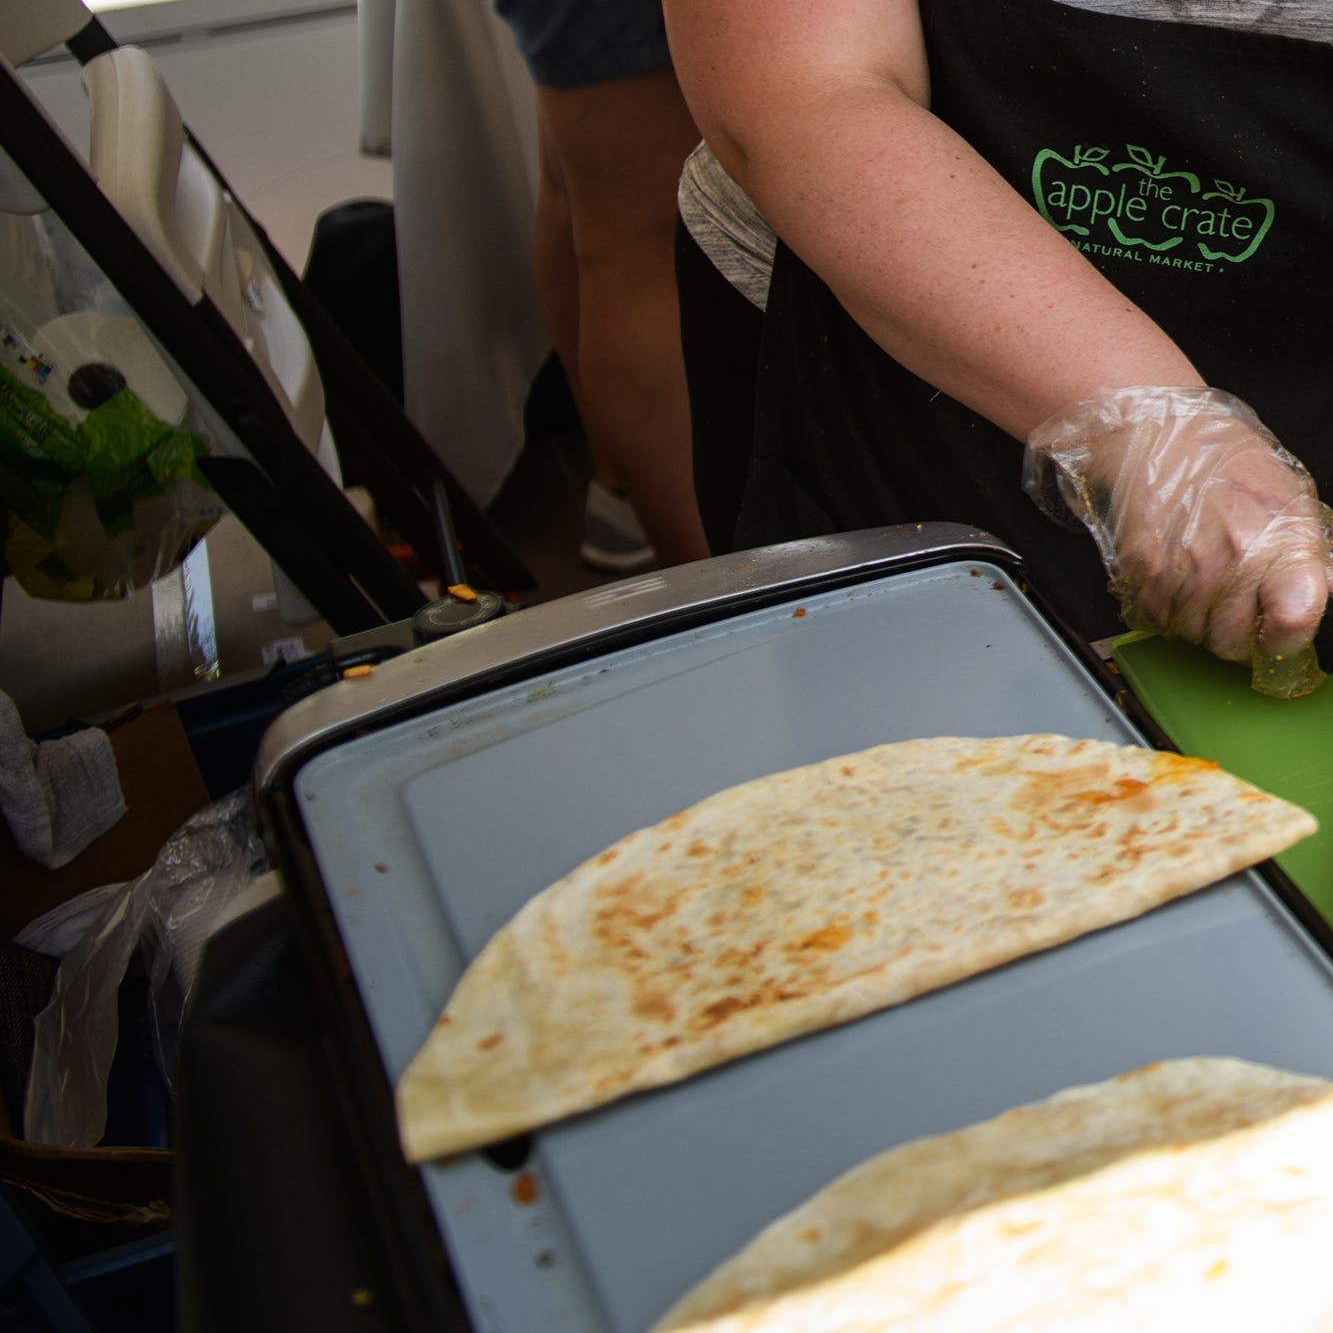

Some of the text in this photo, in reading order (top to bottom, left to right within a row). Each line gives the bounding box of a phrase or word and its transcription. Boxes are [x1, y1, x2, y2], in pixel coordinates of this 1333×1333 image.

[1138, 177, 1173, 201] the
[1047, 179, 1253, 240] apple crate
[1070, 239, 1215, 274] NATURAL MARKET
